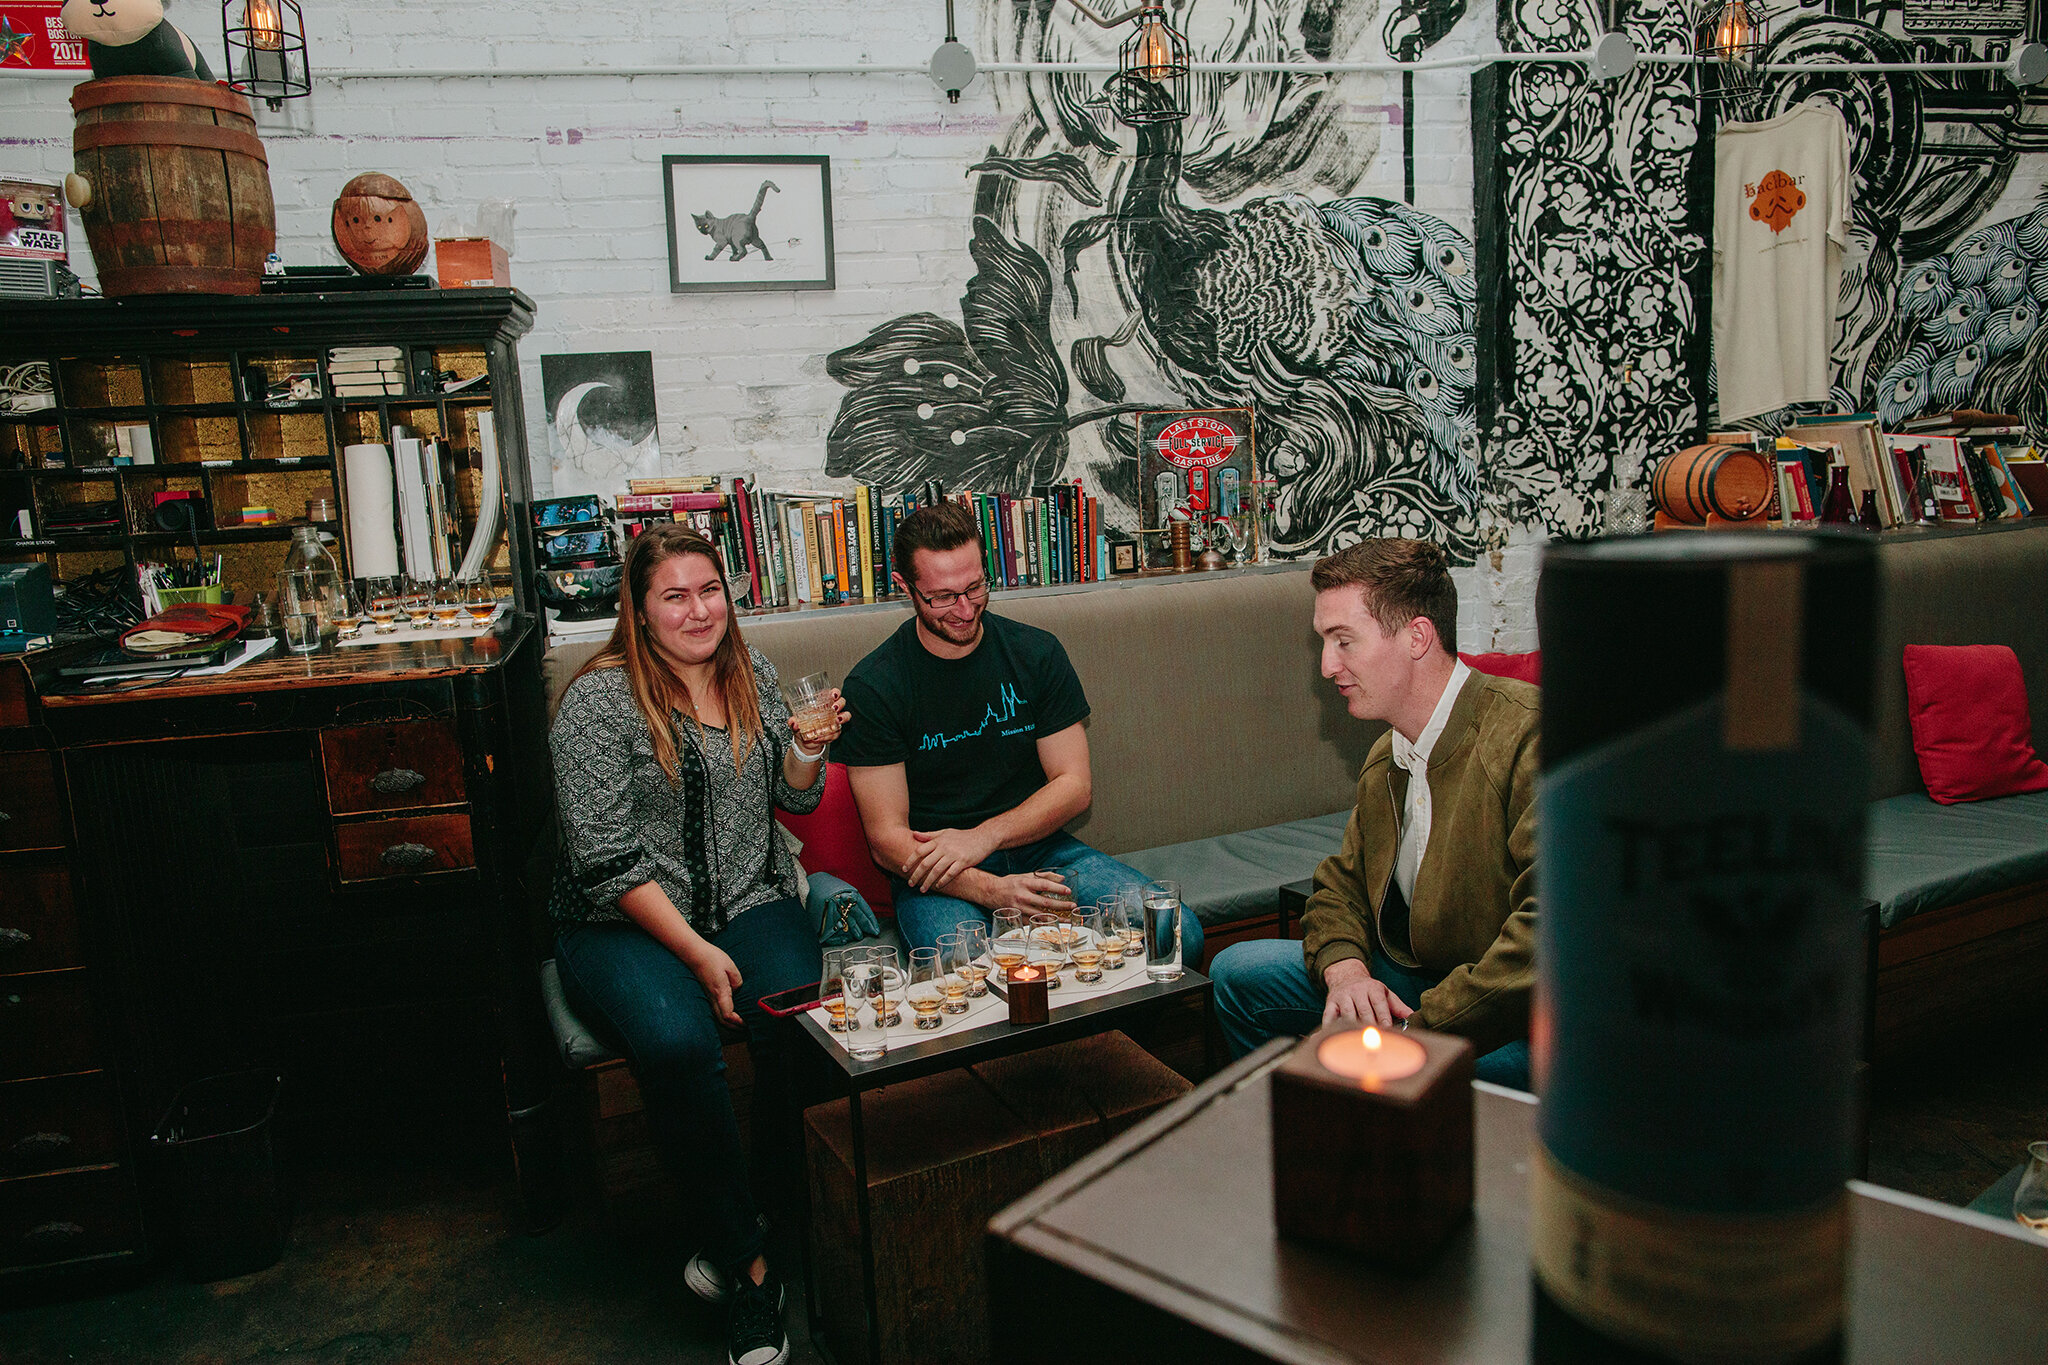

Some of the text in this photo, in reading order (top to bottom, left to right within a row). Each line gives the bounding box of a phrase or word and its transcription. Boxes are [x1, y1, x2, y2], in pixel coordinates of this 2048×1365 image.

[45, 16, 64, 28] BES
[51, 42, 84, 60] 2017
[20, 231, 61, 242] STAR
[21, 239, 62, 250] WARS
[1168, 419, 1225, 435] LAST STOP
[1169, 433, 1225, 452] FULL SERVICE
[1173, 453, 1222, 468] GASOLINE
[871, 487, 881, 551] LIQUID INTELLIGENCE
[847, 527, 857, 547] PDT
[755, 538, 764, 556] BAR
[1001, 727, 1024, 737] Mission
